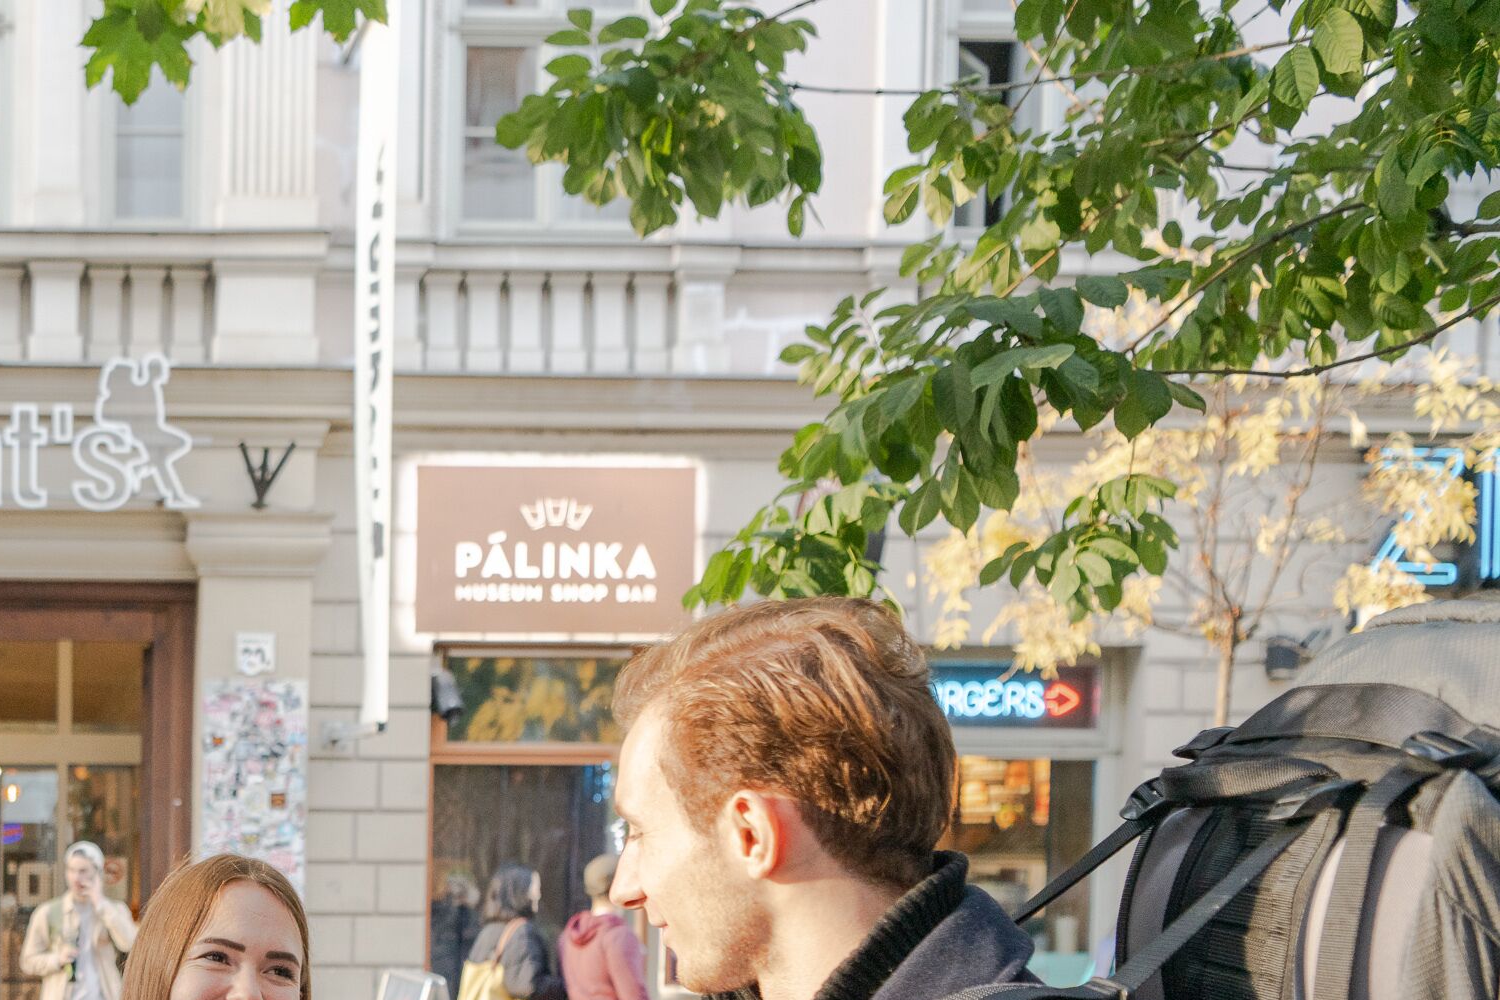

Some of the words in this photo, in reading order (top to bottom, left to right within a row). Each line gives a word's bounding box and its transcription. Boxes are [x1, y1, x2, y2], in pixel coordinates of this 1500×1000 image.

[454, 530, 657, 580] PÁLINKA
[454, 582, 543, 603] MUSEUM
[550, 582, 609, 603] SHOP
[615, 582, 657, 603] BAR
[933, 679, 1046, 719] RGERS
